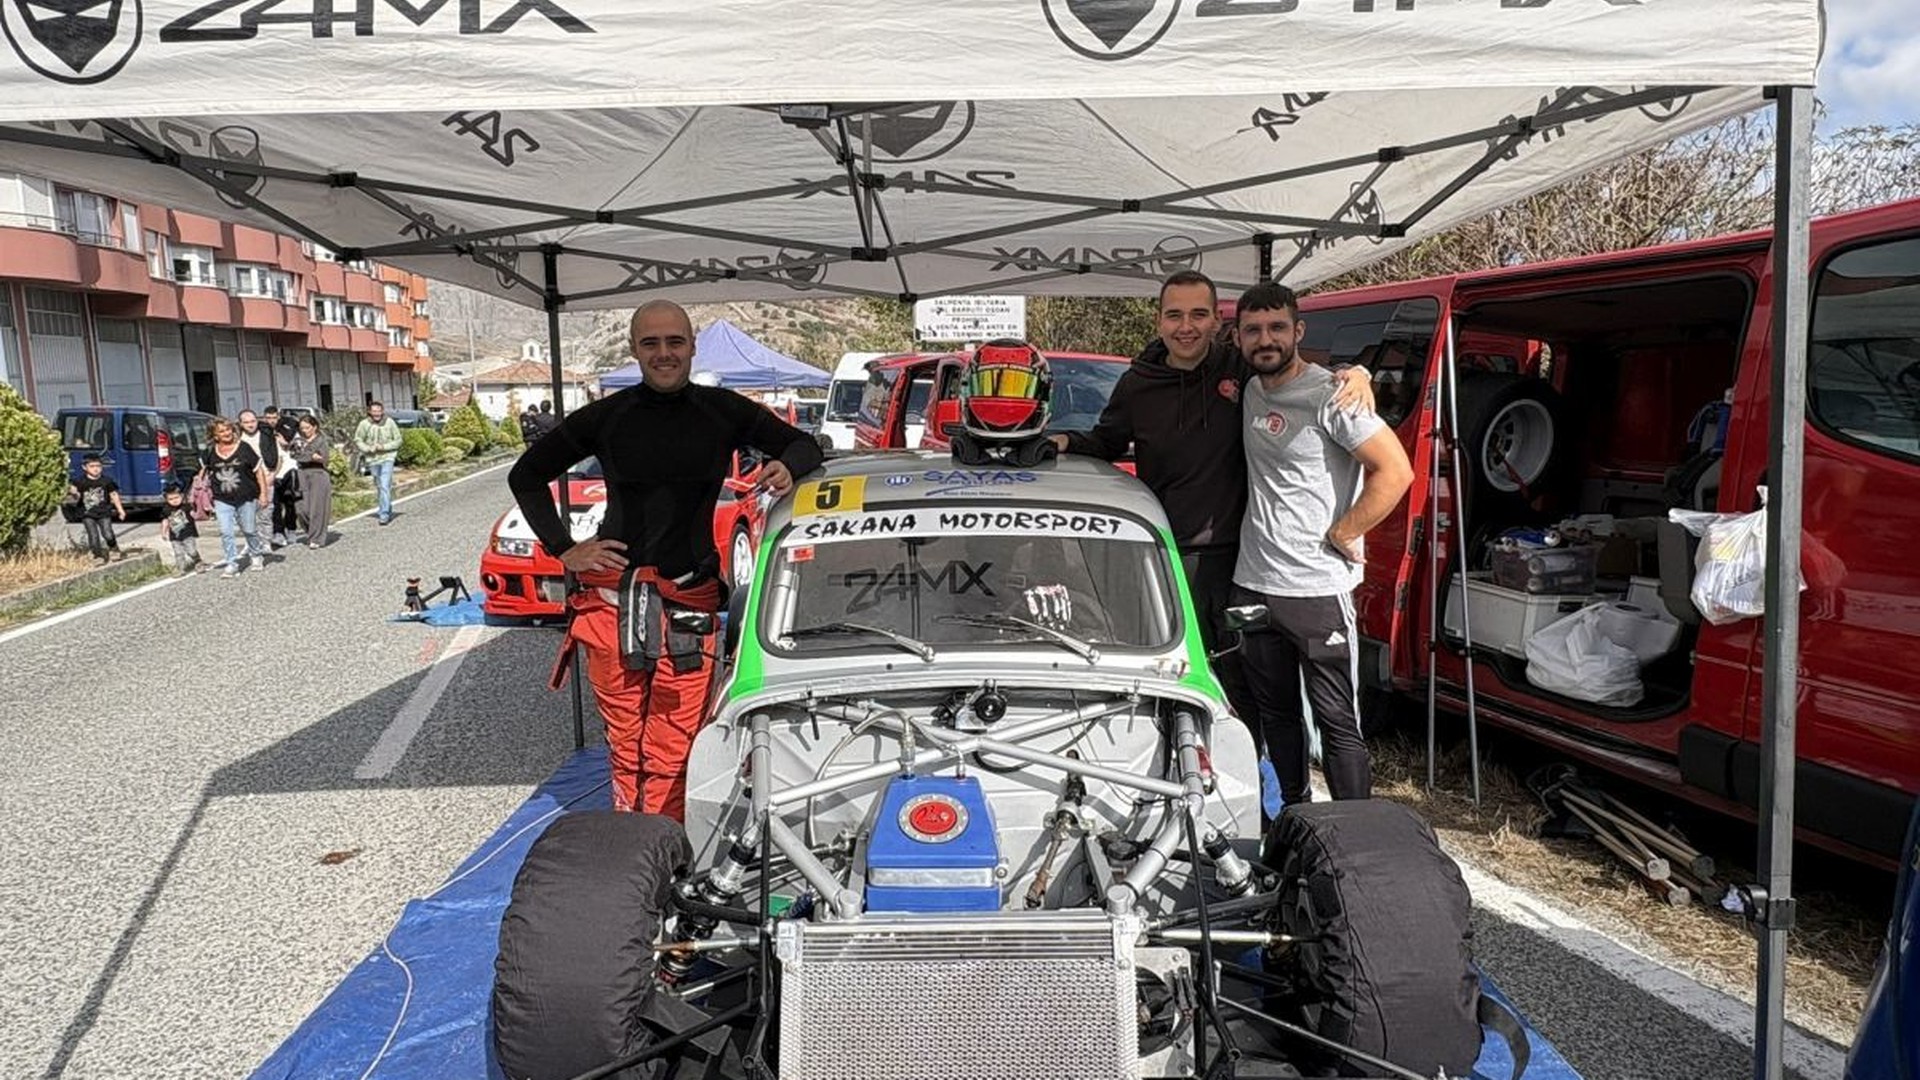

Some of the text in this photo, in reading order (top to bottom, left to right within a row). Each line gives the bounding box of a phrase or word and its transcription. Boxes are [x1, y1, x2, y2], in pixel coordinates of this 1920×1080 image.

[923, 470, 1037, 482] SAYAS
[815, 479, 844, 510] 5
[805, 512, 1122, 539] SAKANA MOTORSPORT
